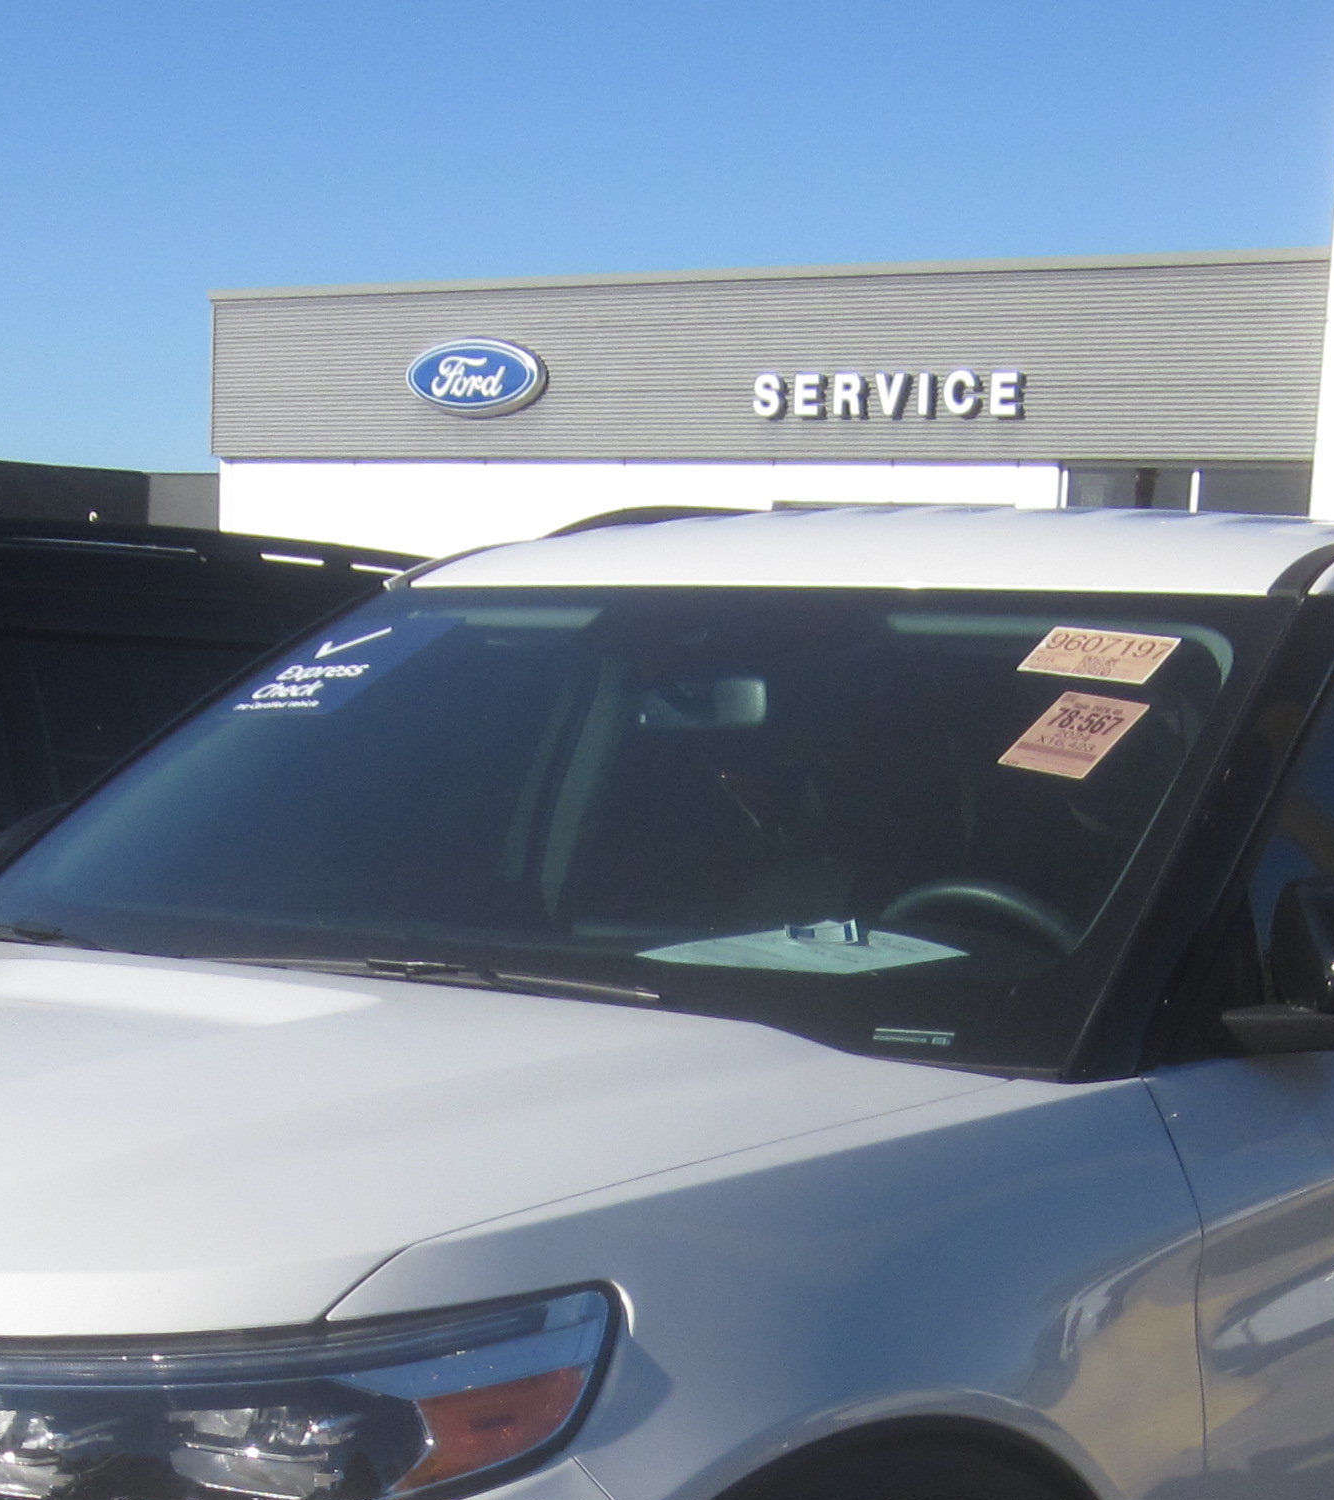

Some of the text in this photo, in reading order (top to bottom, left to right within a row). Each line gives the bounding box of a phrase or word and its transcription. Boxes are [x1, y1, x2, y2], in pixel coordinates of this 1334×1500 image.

[430, 355, 507, 398] Ford
[752, 368, 1021, 417] SERVICE
[1045, 632, 1174, 660] 9607197
[275, 664, 370, 682] Express
[251, 679, 324, 699] Check
[1046, 706, 1126, 736] 78:567
